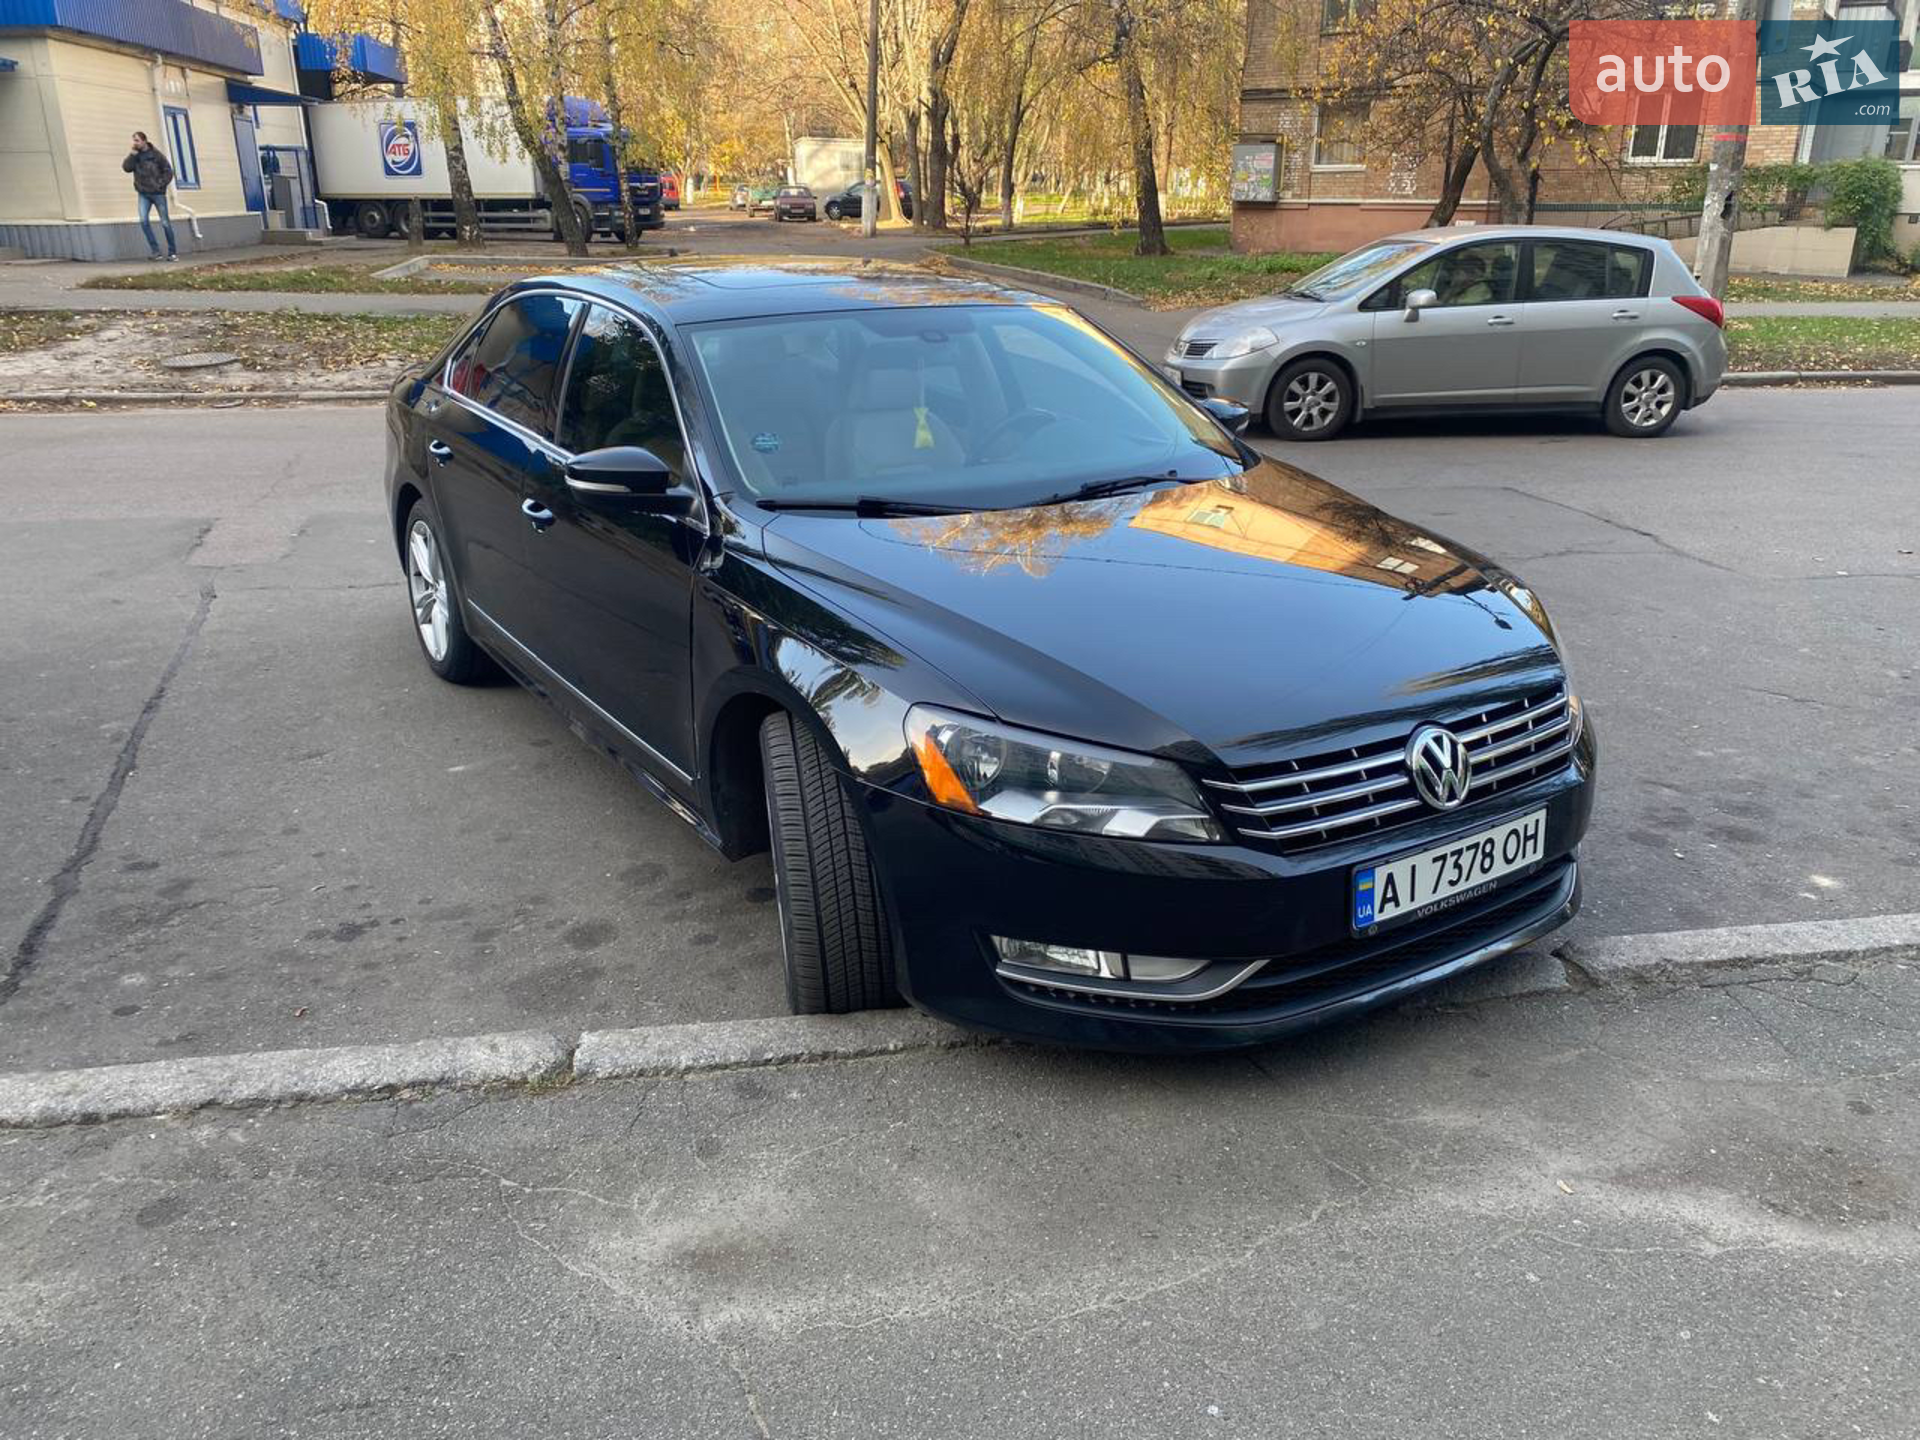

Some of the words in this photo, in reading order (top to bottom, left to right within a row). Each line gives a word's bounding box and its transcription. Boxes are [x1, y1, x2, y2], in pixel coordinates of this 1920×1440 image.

[1378, 864, 1417, 914] AI
[1432, 837, 1495, 894] 7378
[1503, 819, 1540, 864] OH
[1357, 905, 1373, 918] UA
[1416, 882, 1497, 918] VOLKSWAGEN
